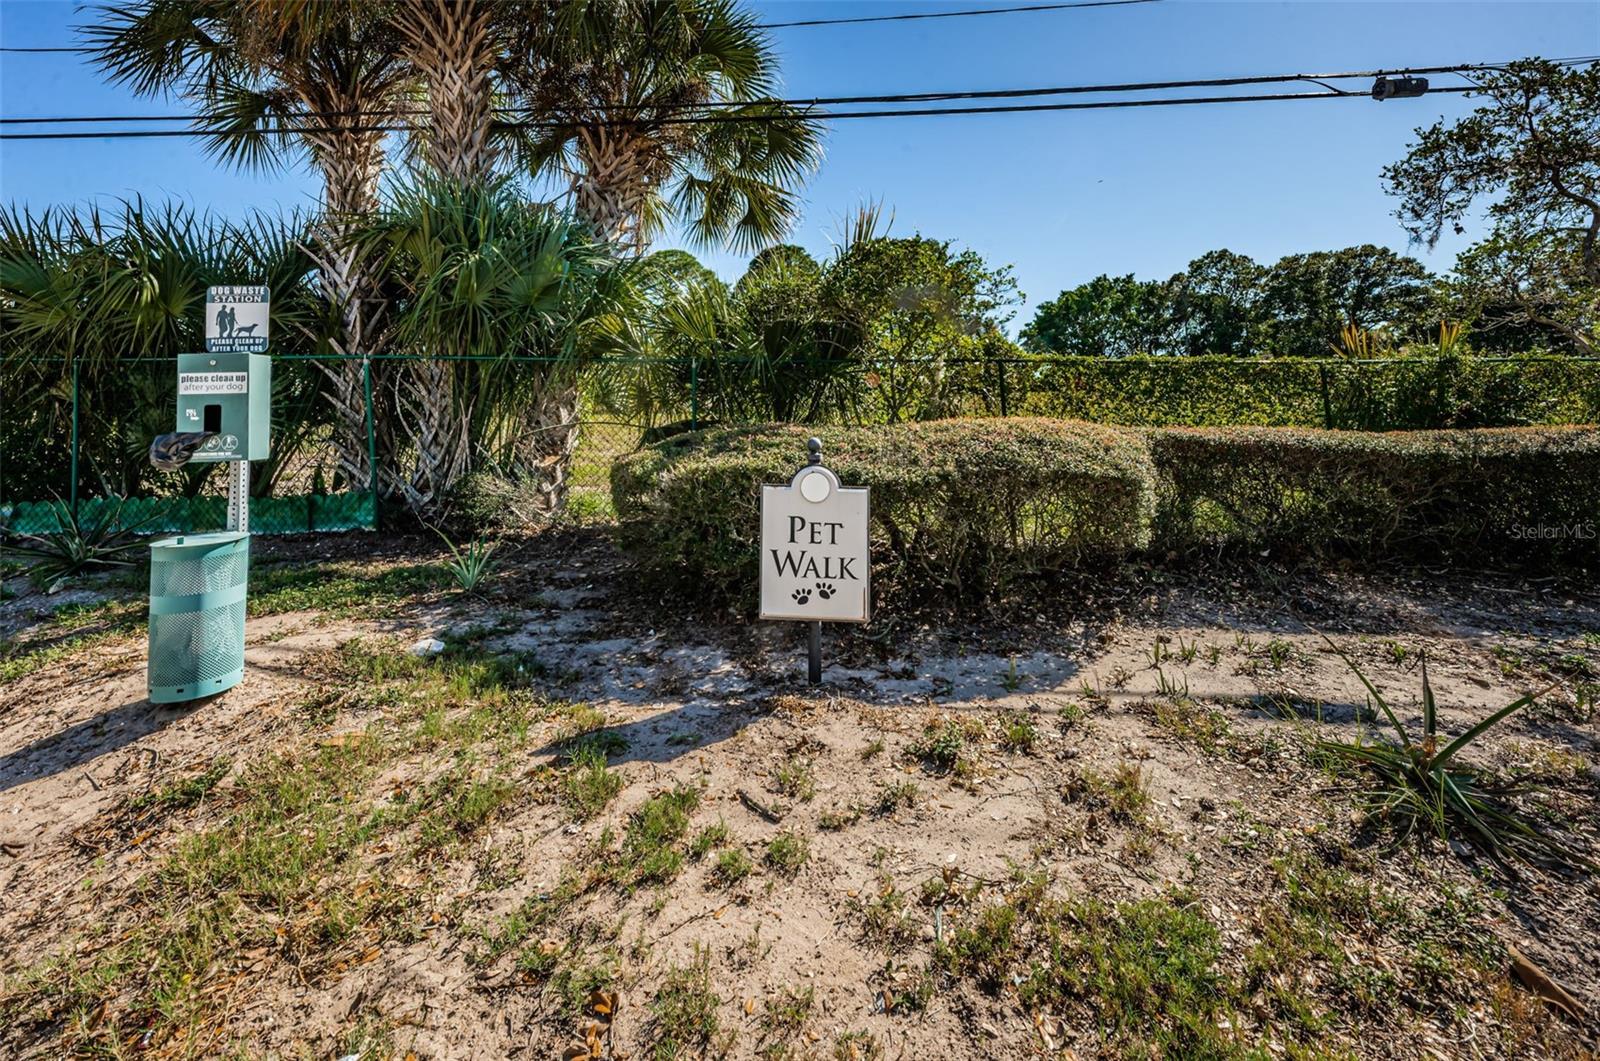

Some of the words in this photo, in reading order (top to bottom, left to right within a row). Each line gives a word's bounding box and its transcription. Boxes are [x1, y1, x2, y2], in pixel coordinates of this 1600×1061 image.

[211, 286, 230, 295] DOG
[232, 286, 265, 295] WASTE
[214, 295, 262, 303] STATION
[180, 374, 209, 384] please
[210, 374, 234, 383] clean
[235, 374, 246, 383] up
[183, 383, 204, 391] after
[204, 384, 225, 392] your
[226, 382, 244, 391] dog
